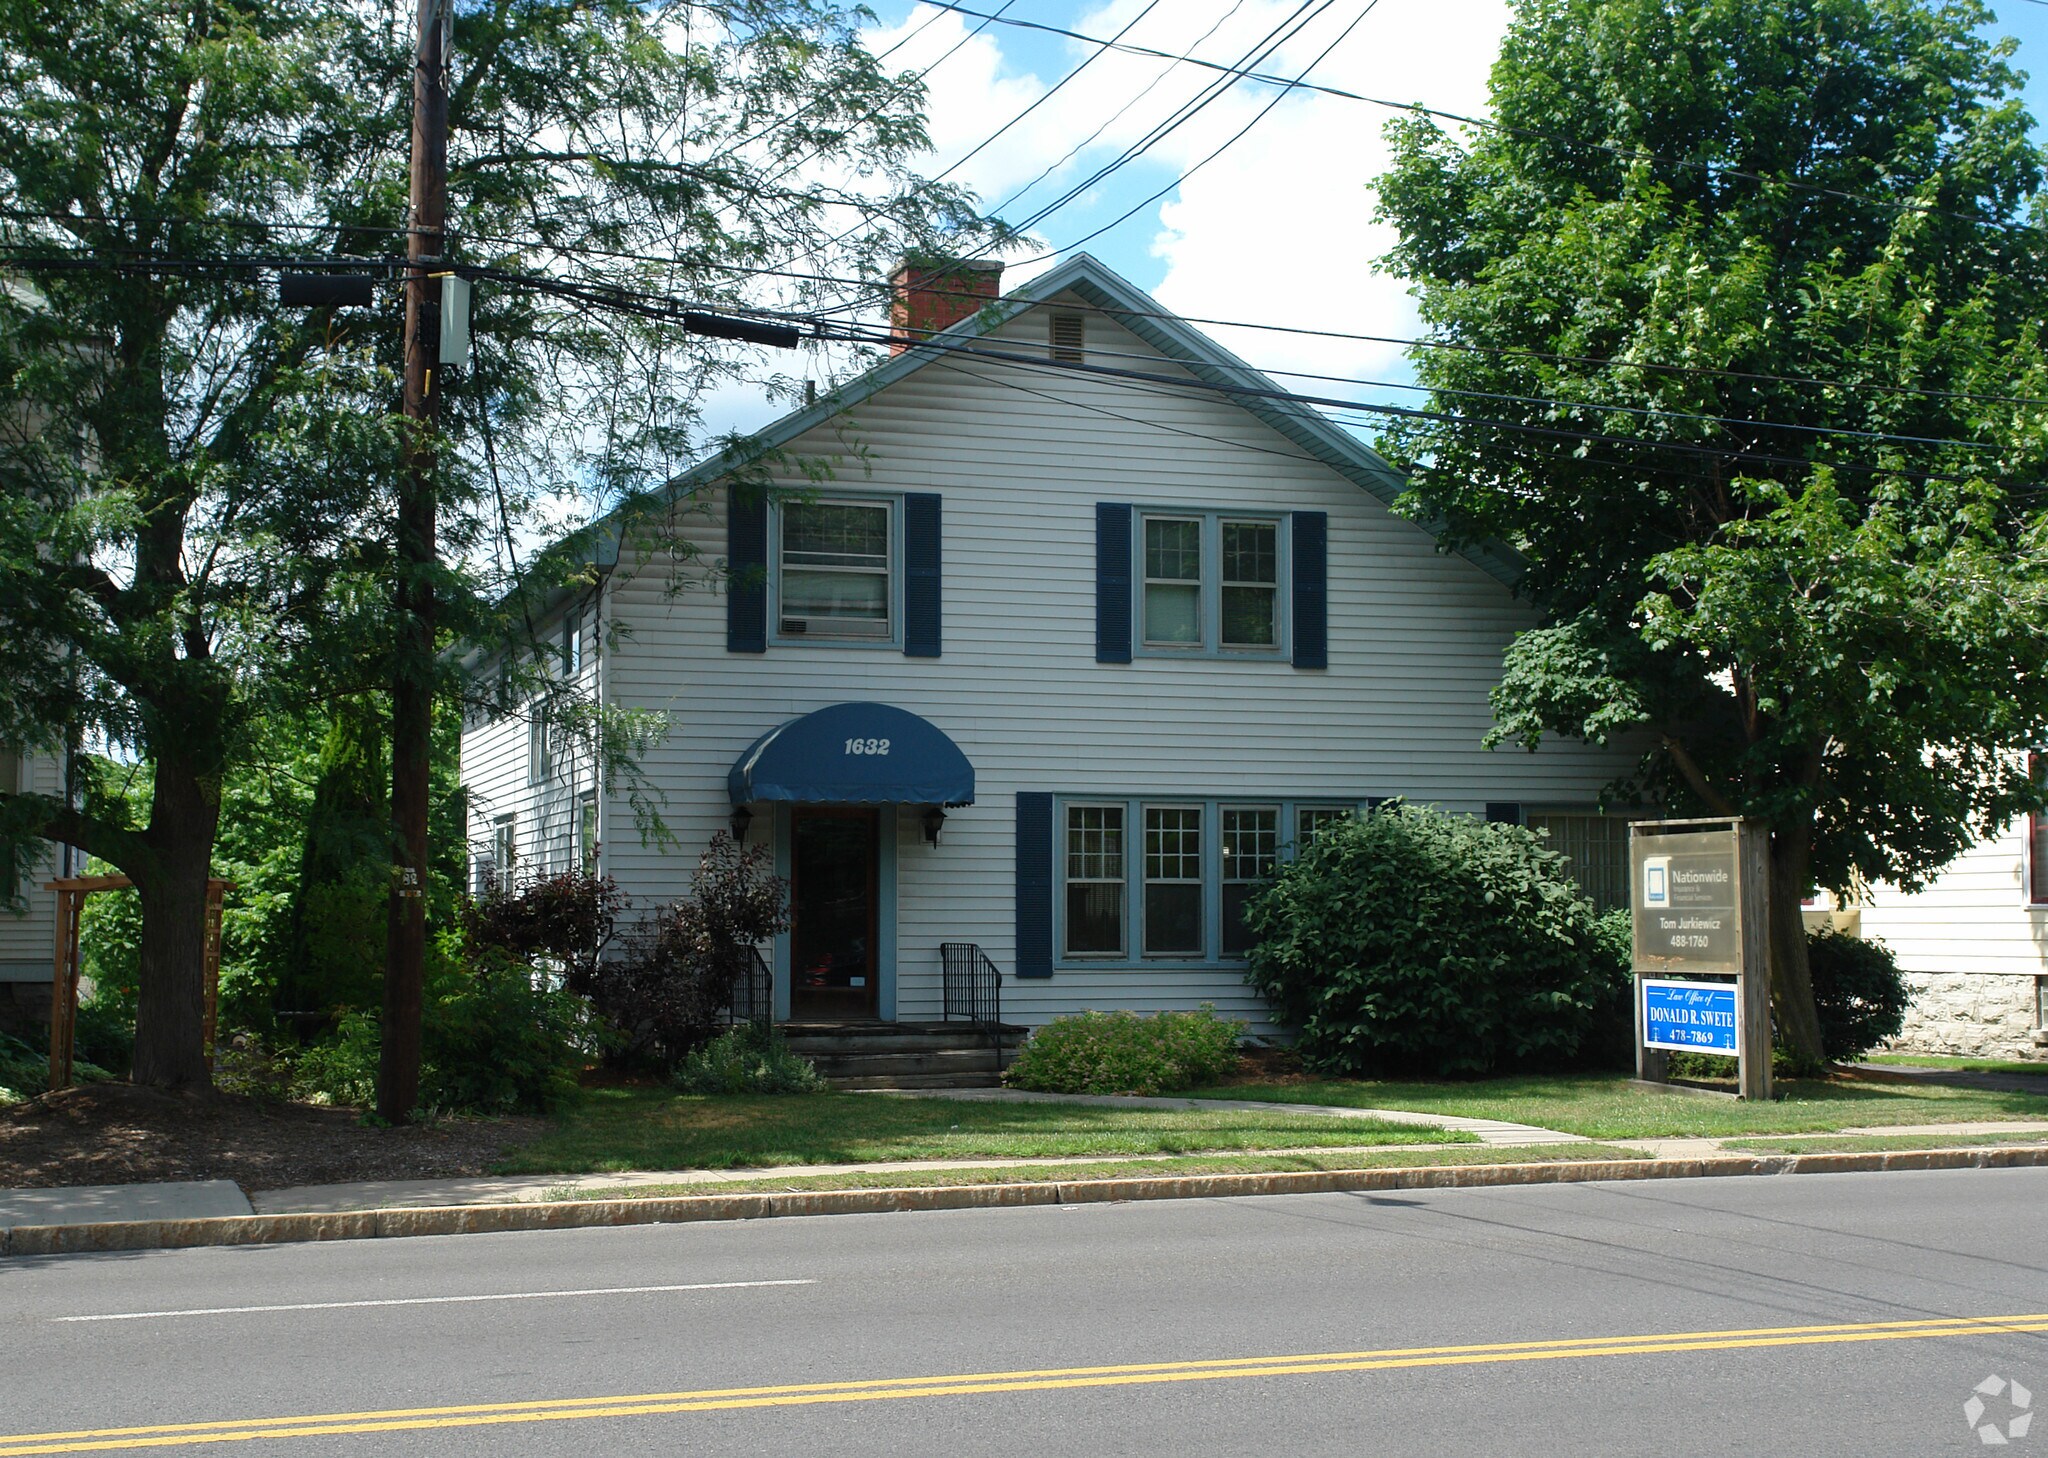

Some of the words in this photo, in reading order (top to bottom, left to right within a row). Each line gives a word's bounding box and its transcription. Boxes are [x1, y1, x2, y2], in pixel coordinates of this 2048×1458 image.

[844, 738, 891, 756] 1632
[1672, 868, 1728, 883] Nationwide
[1659, 917, 1676, 929] Tom
[1678, 917, 1721, 929] Jurkiewicz
[1670, 935, 1709, 948] 488-1760
[1666, 988, 1683, 1001] Law
[1684, 990, 1703, 1005] Office
[1704, 992, 1715, 1006] of
[1650, 1006, 1689, 1024] DONALD
[1690, 1009, 1700, 1025] R.
[1700, 1010, 1734, 1028] SWETE
[1669, 1028, 1714, 1044] 478-7869
